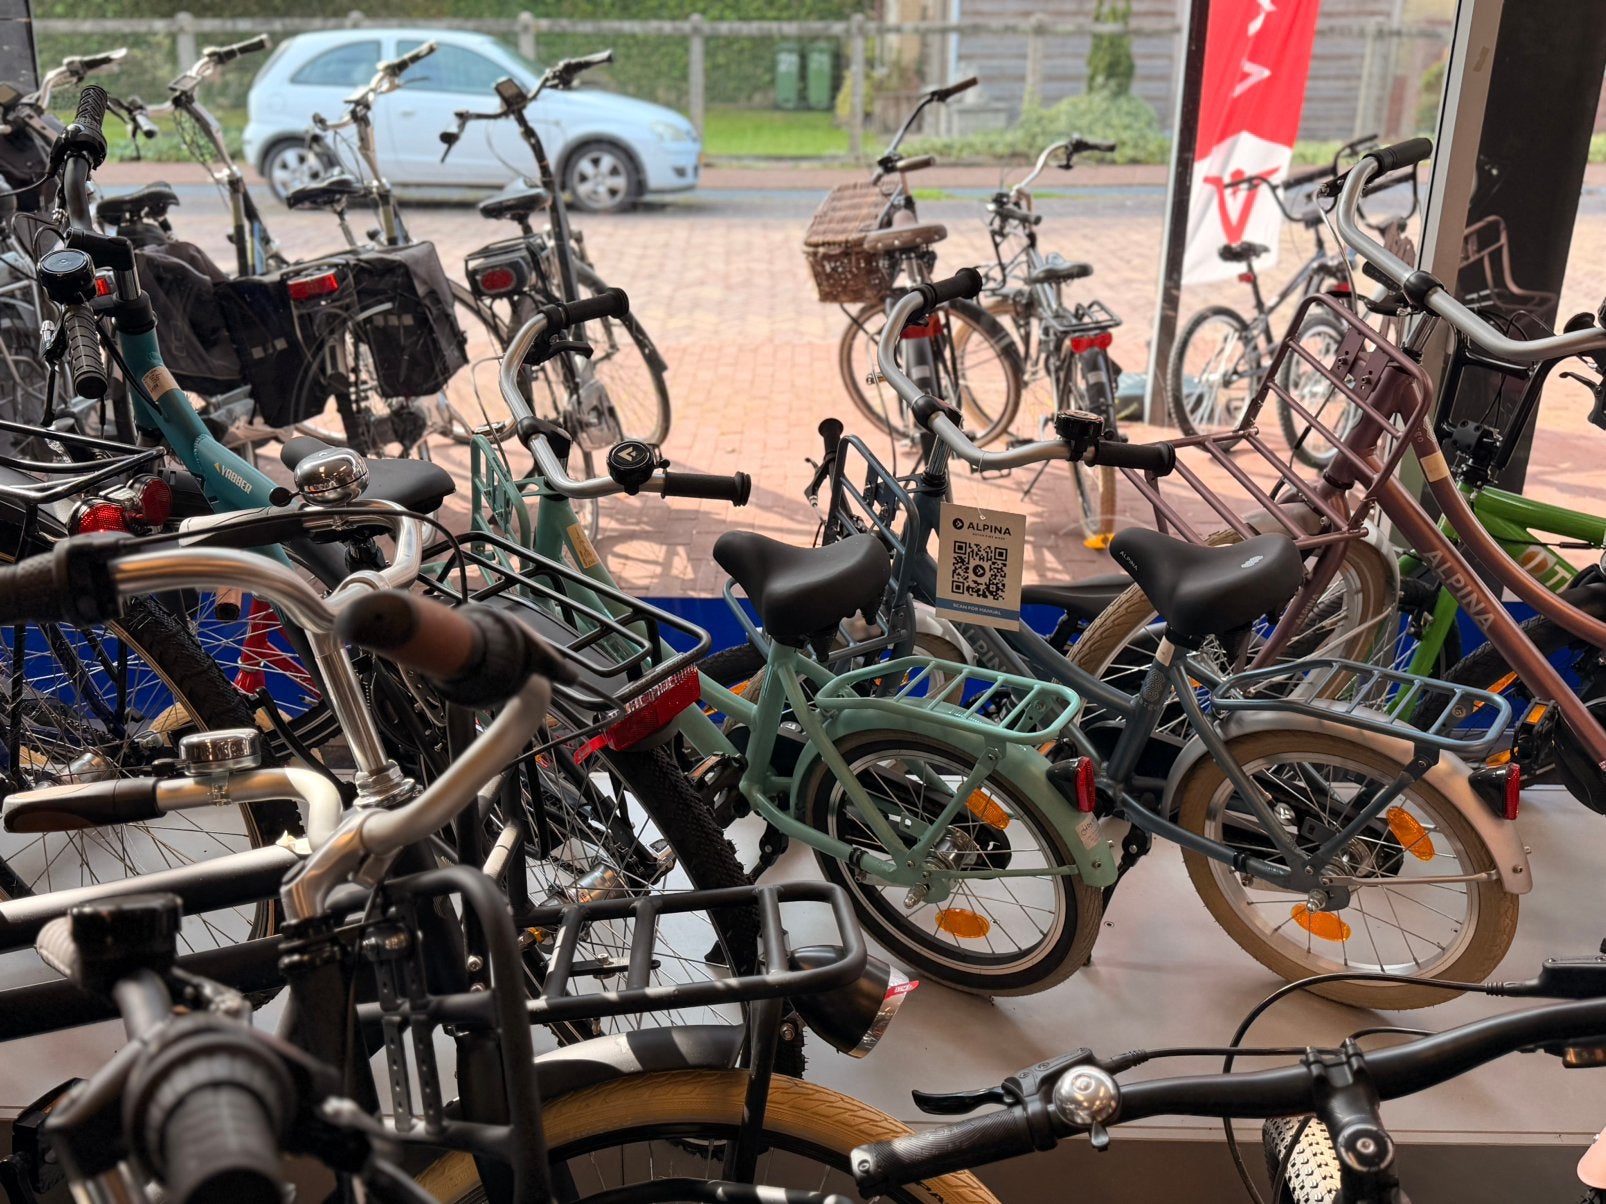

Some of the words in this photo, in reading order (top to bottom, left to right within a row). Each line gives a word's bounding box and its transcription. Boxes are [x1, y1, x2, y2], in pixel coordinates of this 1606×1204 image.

[221, 465, 252, 494] YABBER
[967, 522, 1012, 536] ALPINA
[1423, 551, 1494, 631] ALPINA
